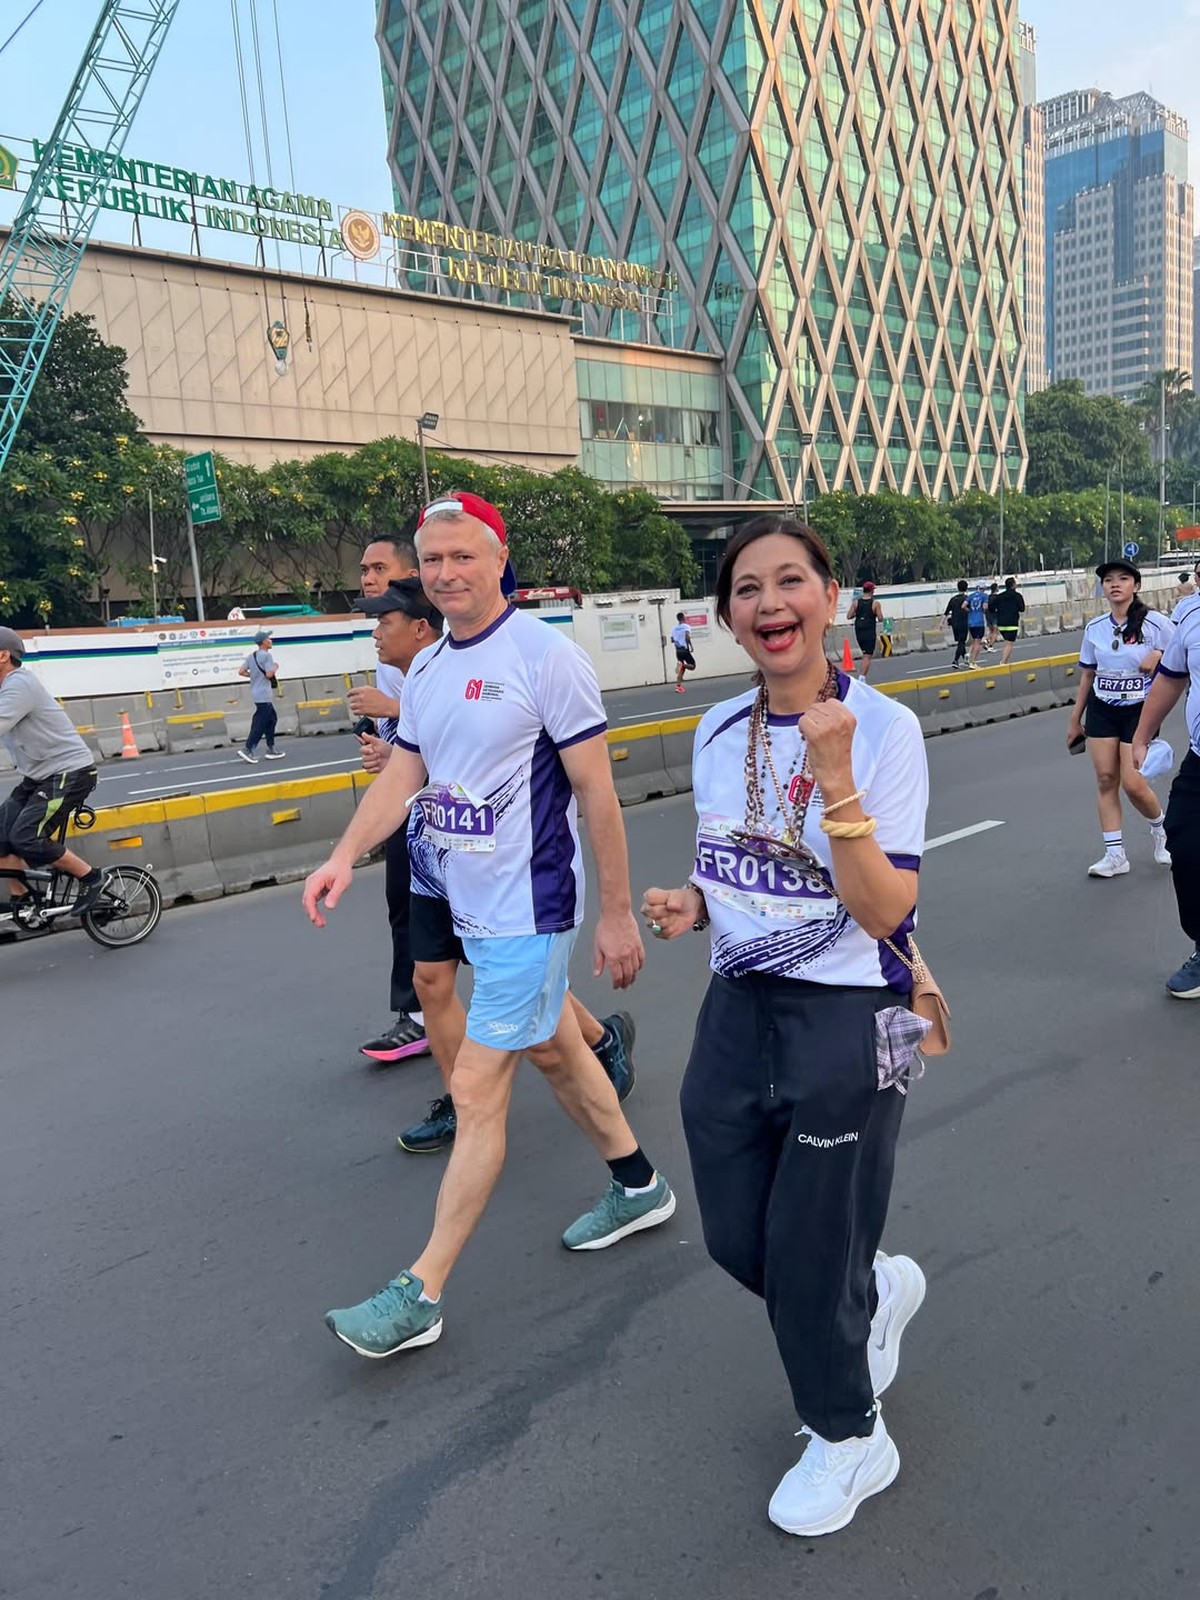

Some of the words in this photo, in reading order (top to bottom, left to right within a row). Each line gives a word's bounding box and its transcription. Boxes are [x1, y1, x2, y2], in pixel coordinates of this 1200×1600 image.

[247, 184, 333, 221] AGAMA
[205, 204, 346, 251] INDONESIA
[465, 679, 483, 700] 61
[1100, 679, 1141, 690] FR7183
[420, 801, 486, 831] FR0141
[798, 1133, 834, 1148] CALVIN
[834, 1131, 858, 1146] KLEIN
